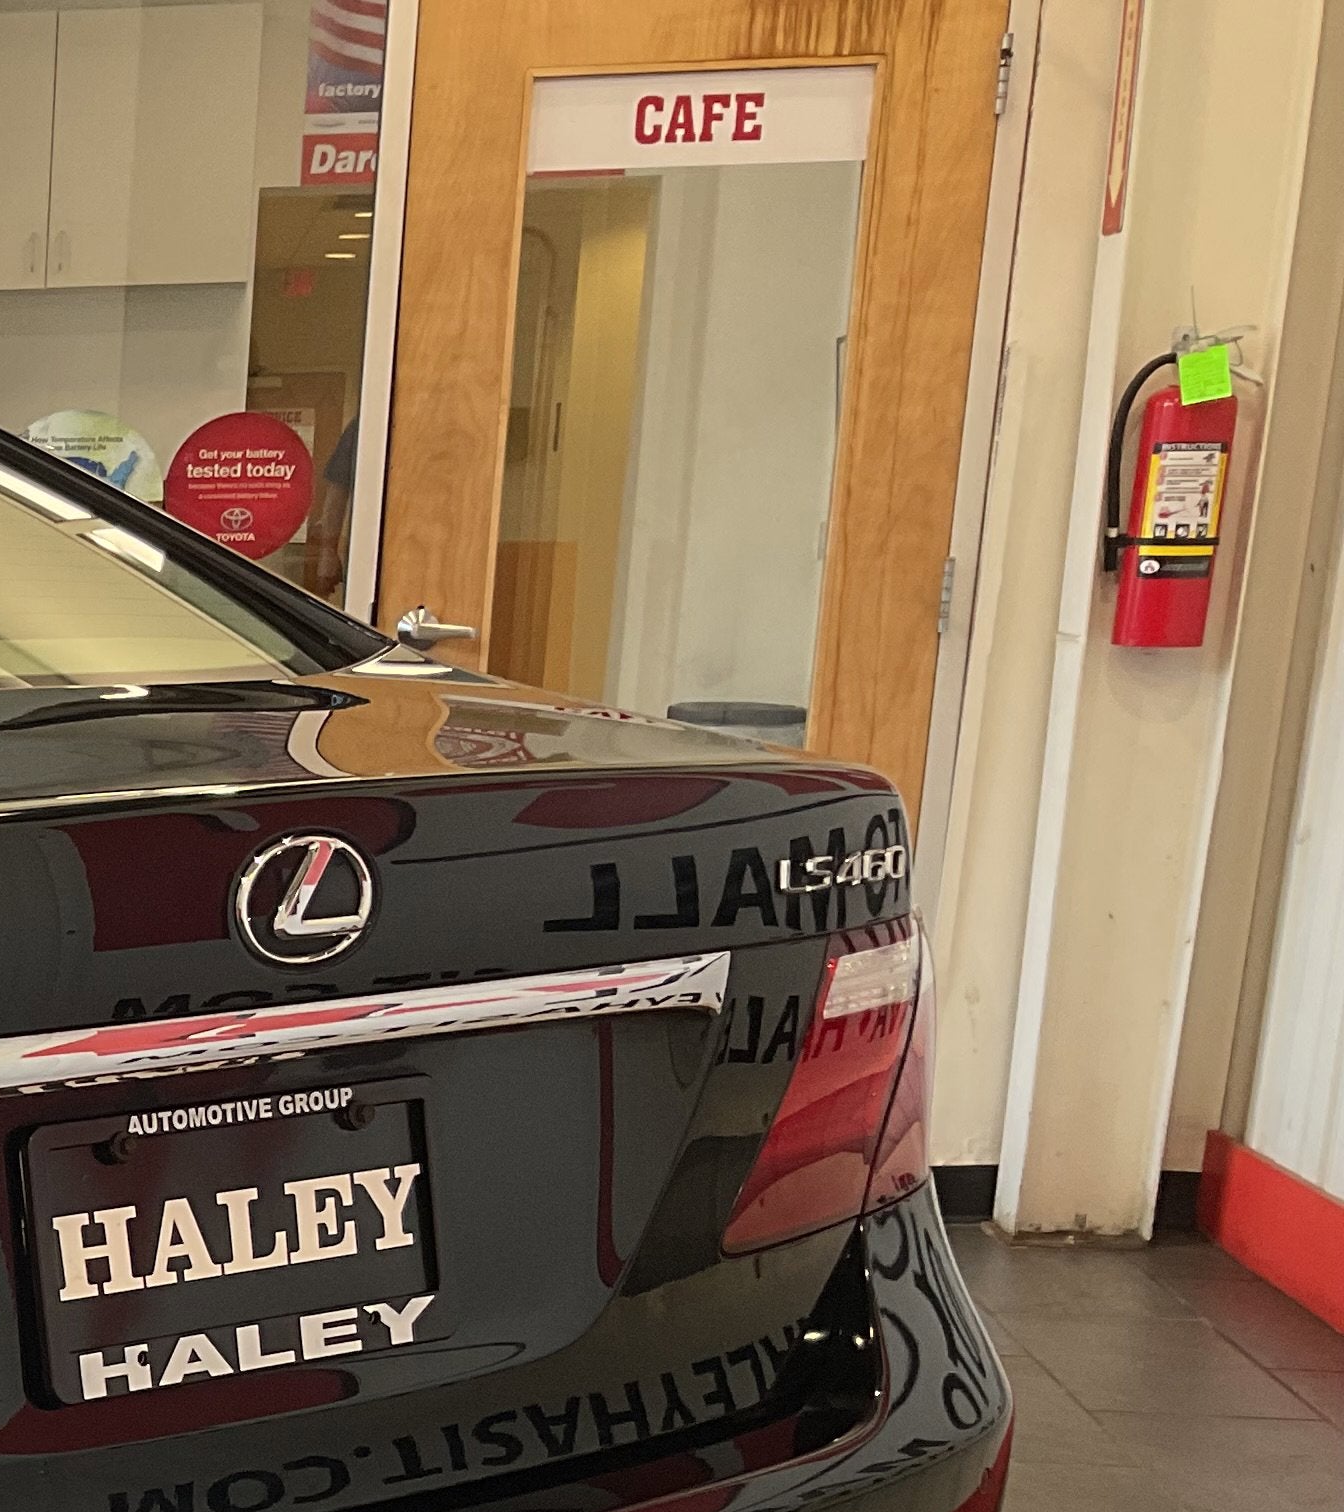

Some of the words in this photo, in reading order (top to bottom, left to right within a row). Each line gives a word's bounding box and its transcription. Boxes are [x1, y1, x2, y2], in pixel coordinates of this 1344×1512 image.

[633, 92, 765, 145] CAFE
[309, 142, 377, 175] Dar
[186, 462, 242, 479] tested
[246, 461, 296, 480] today
[198, 448, 218, 460] Get
[220, 450, 243, 461] your
[245, 448, 286, 461] battery
[215, 532, 256, 543] TOYOTA
[127, 1095, 272, 1136] AUTOMOTIVE
[278, 1087, 353, 1115] GROUP
[52, 1162, 422, 1303] HALEY
[78, 1294, 436, 1401] HALEY
